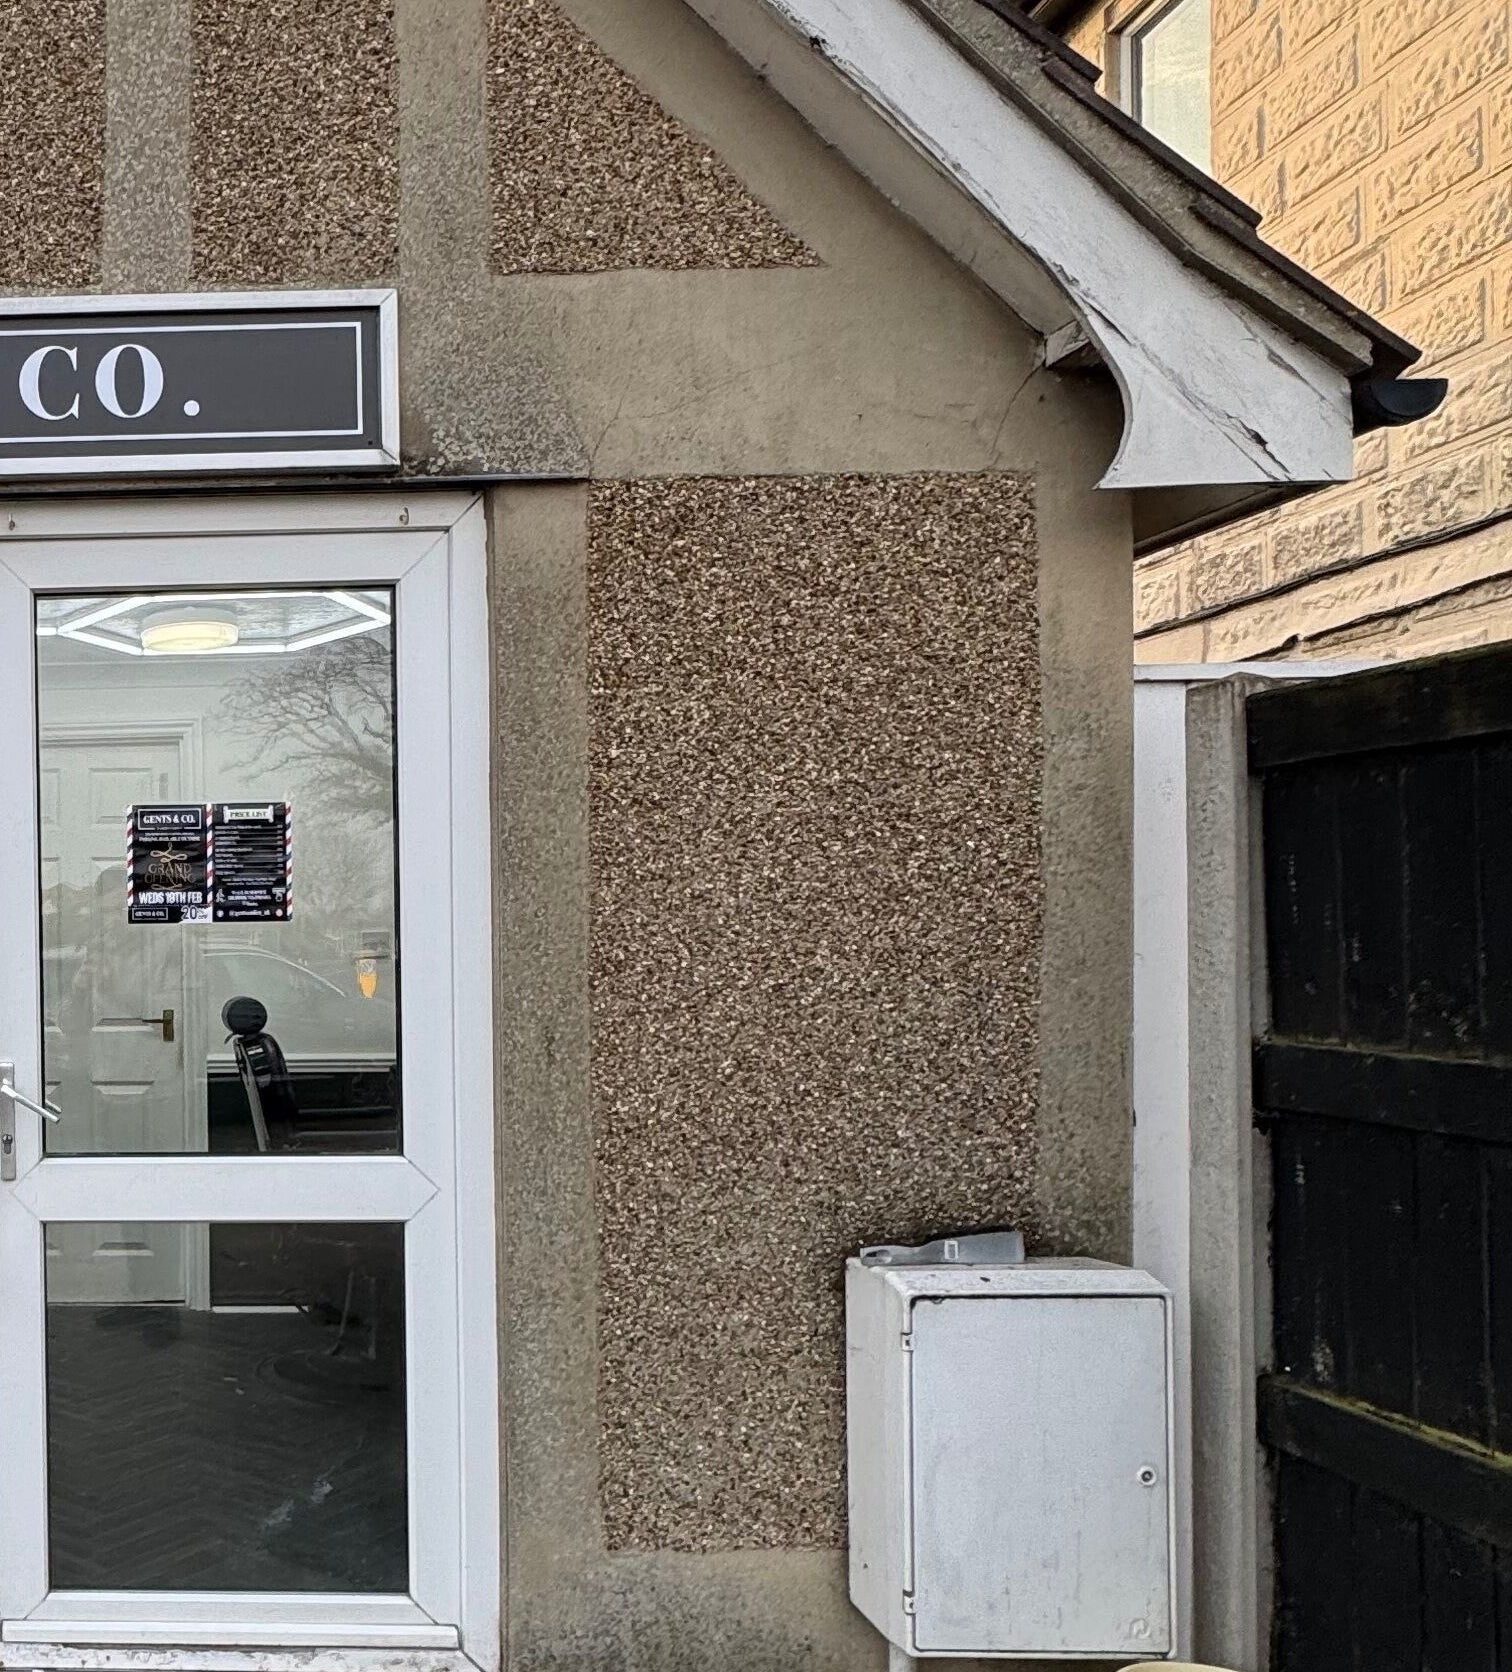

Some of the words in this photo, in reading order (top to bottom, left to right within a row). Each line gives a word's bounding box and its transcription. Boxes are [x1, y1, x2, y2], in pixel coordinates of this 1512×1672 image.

[18, 343, 200, 421] CO.
[143, 815, 172, 823] GENTS
[173, 815, 180, 823] &
[181, 814, 196, 823] CO.
[148, 863, 192, 874] GRAND
[139, 892, 165, 904] WEDS
[188, 892, 202, 904] FEB
[181, 907, 196, 920] 20
